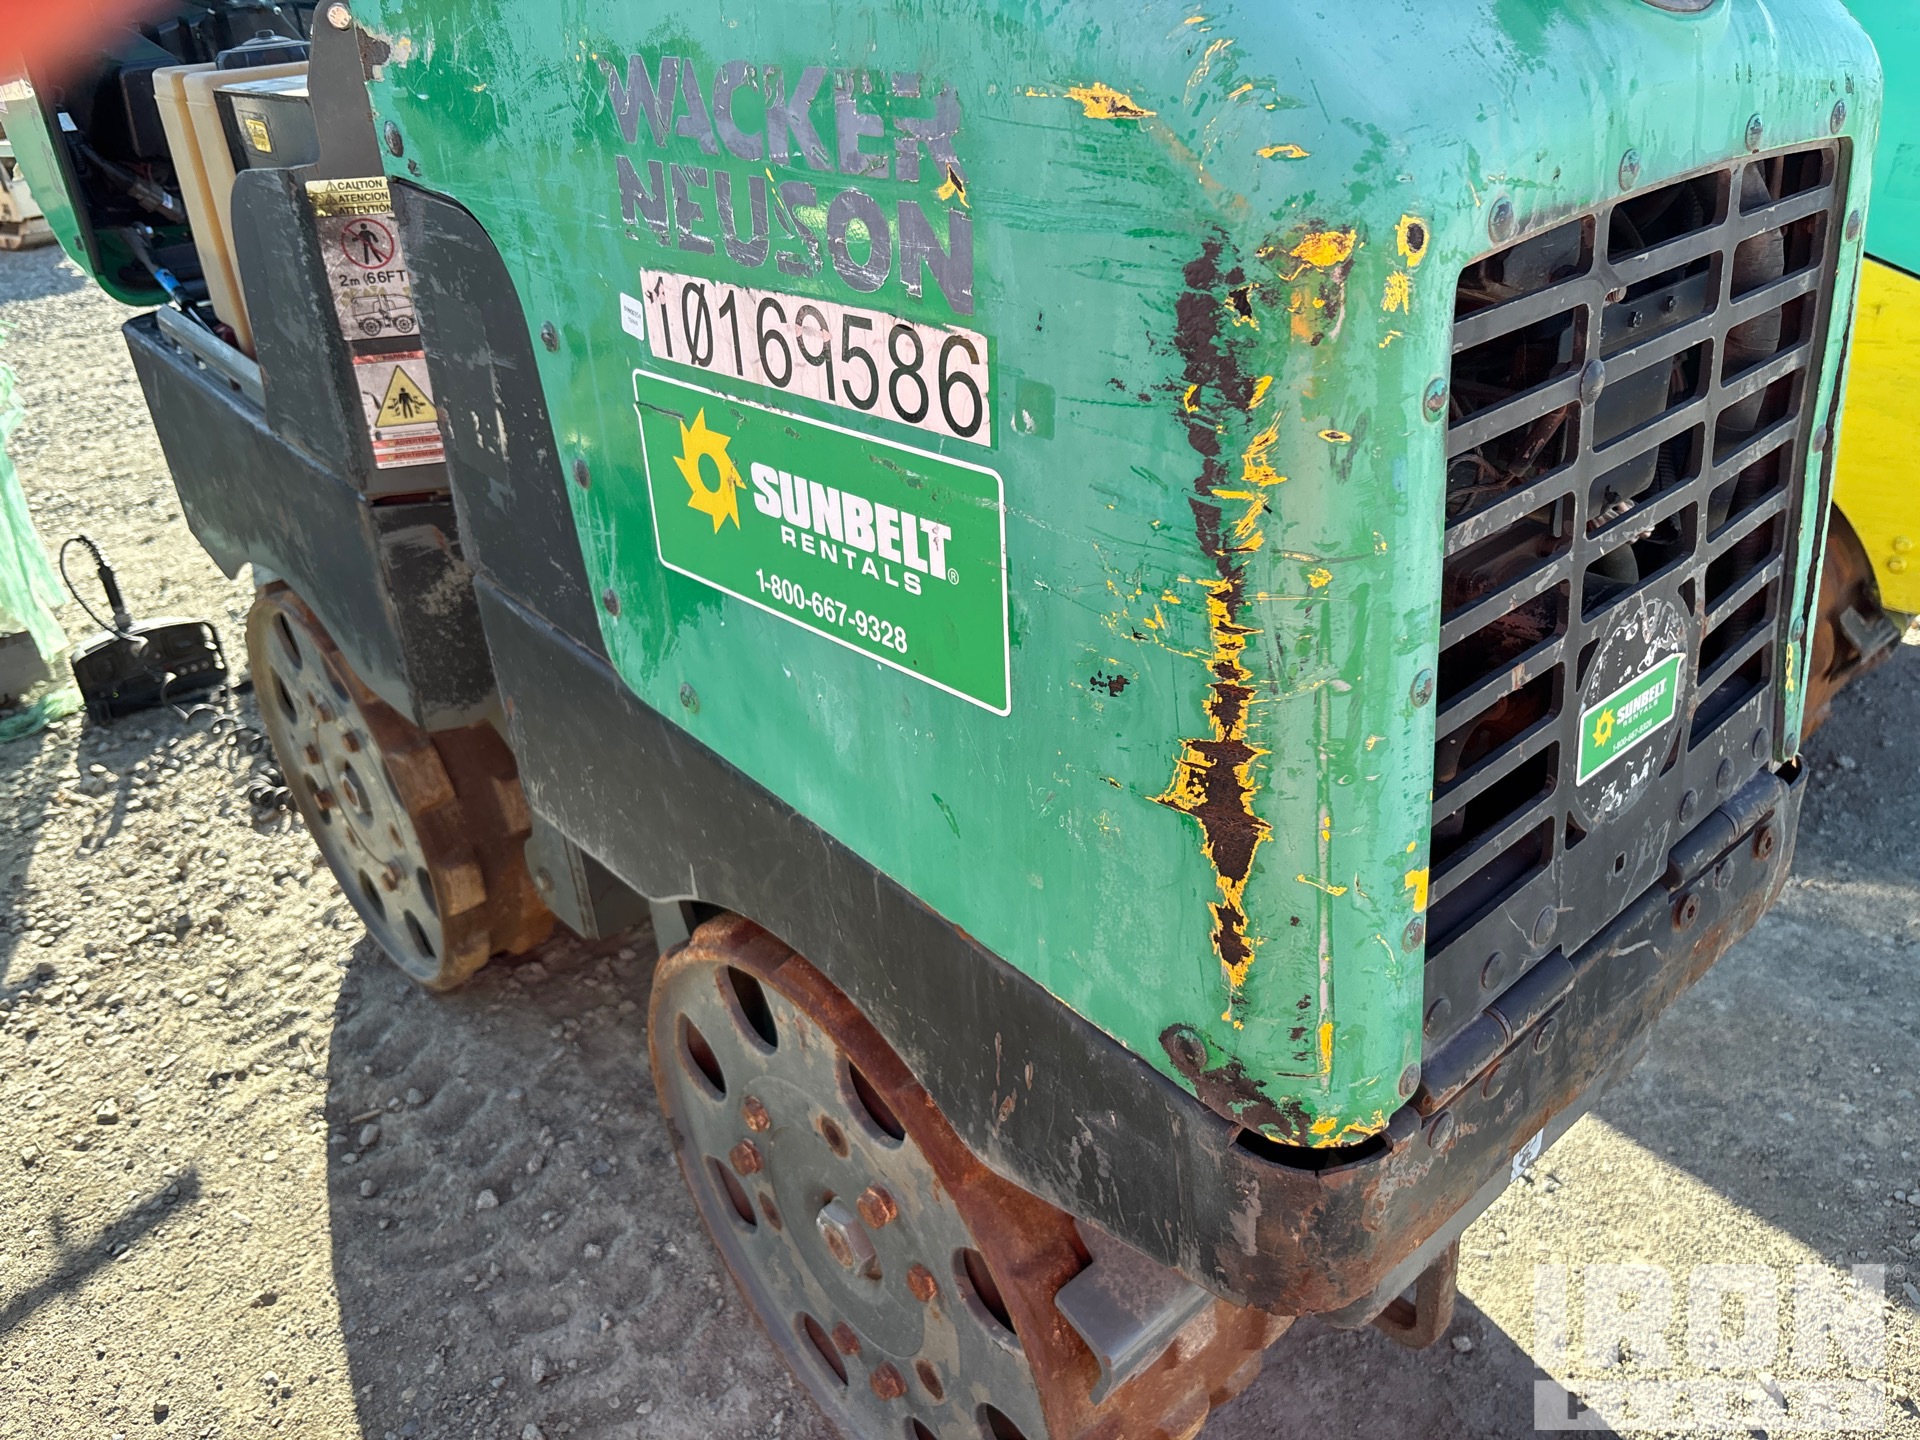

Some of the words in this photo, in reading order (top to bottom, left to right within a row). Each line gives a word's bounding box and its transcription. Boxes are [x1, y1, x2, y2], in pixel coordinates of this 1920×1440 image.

[602, 54, 969, 188] WACKER
[337, 179, 383, 190] CAUTION
[615, 154, 974, 316] NEUSON
[645, 276, 984, 439] 10169586
[750, 461, 952, 581] SUNBELT
[781, 524, 922, 596] RENTALS
[755, 568, 909, 654] 1-800-667-9328
[1616, 677, 1668, 725] SUNBELT
[1622, 698, 1659, 728] RENTALS
